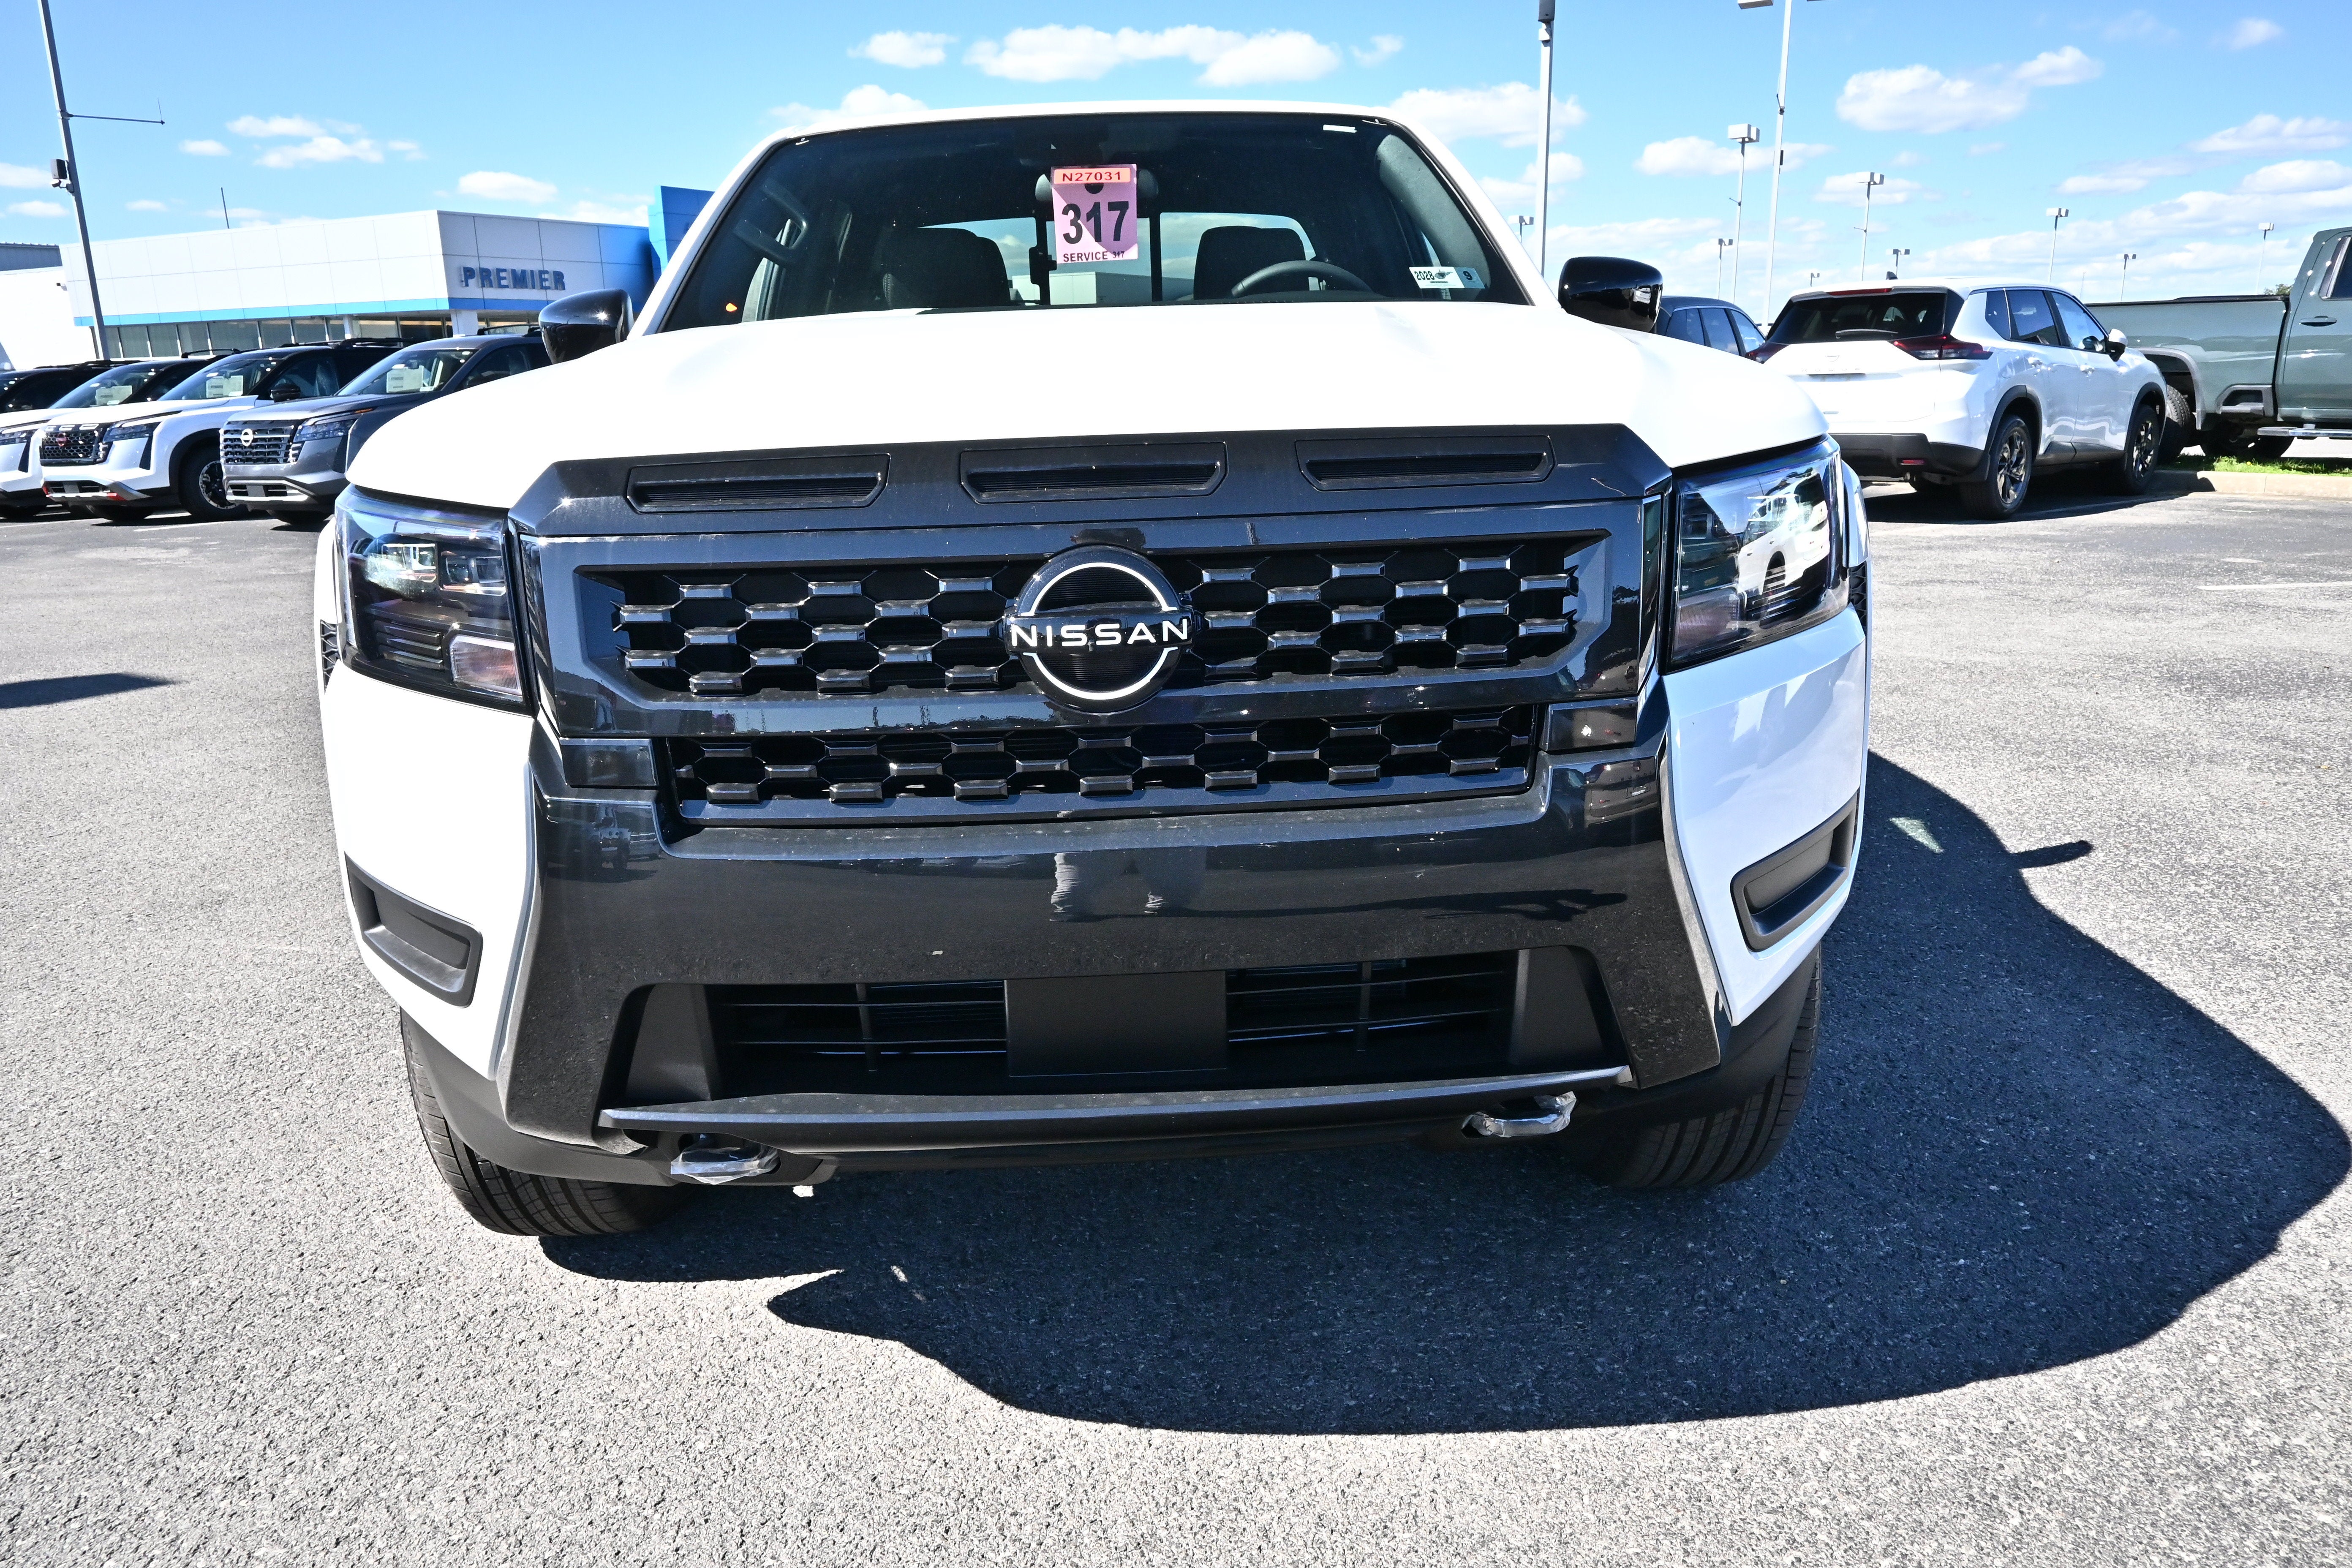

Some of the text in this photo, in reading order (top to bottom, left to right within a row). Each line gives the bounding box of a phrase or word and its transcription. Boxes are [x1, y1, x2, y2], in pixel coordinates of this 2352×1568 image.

[1062, 171, 1121, 182] N27031
[1062, 201, 1129, 245] 317
[1063, 250, 1108, 262] SERVICE
[461, 266, 566, 290] PREMIER
[1414, 270, 1435, 280] 2028
[1463, 270, 1473, 280] 9
[1011, 618, 1188, 647] NISSAN
